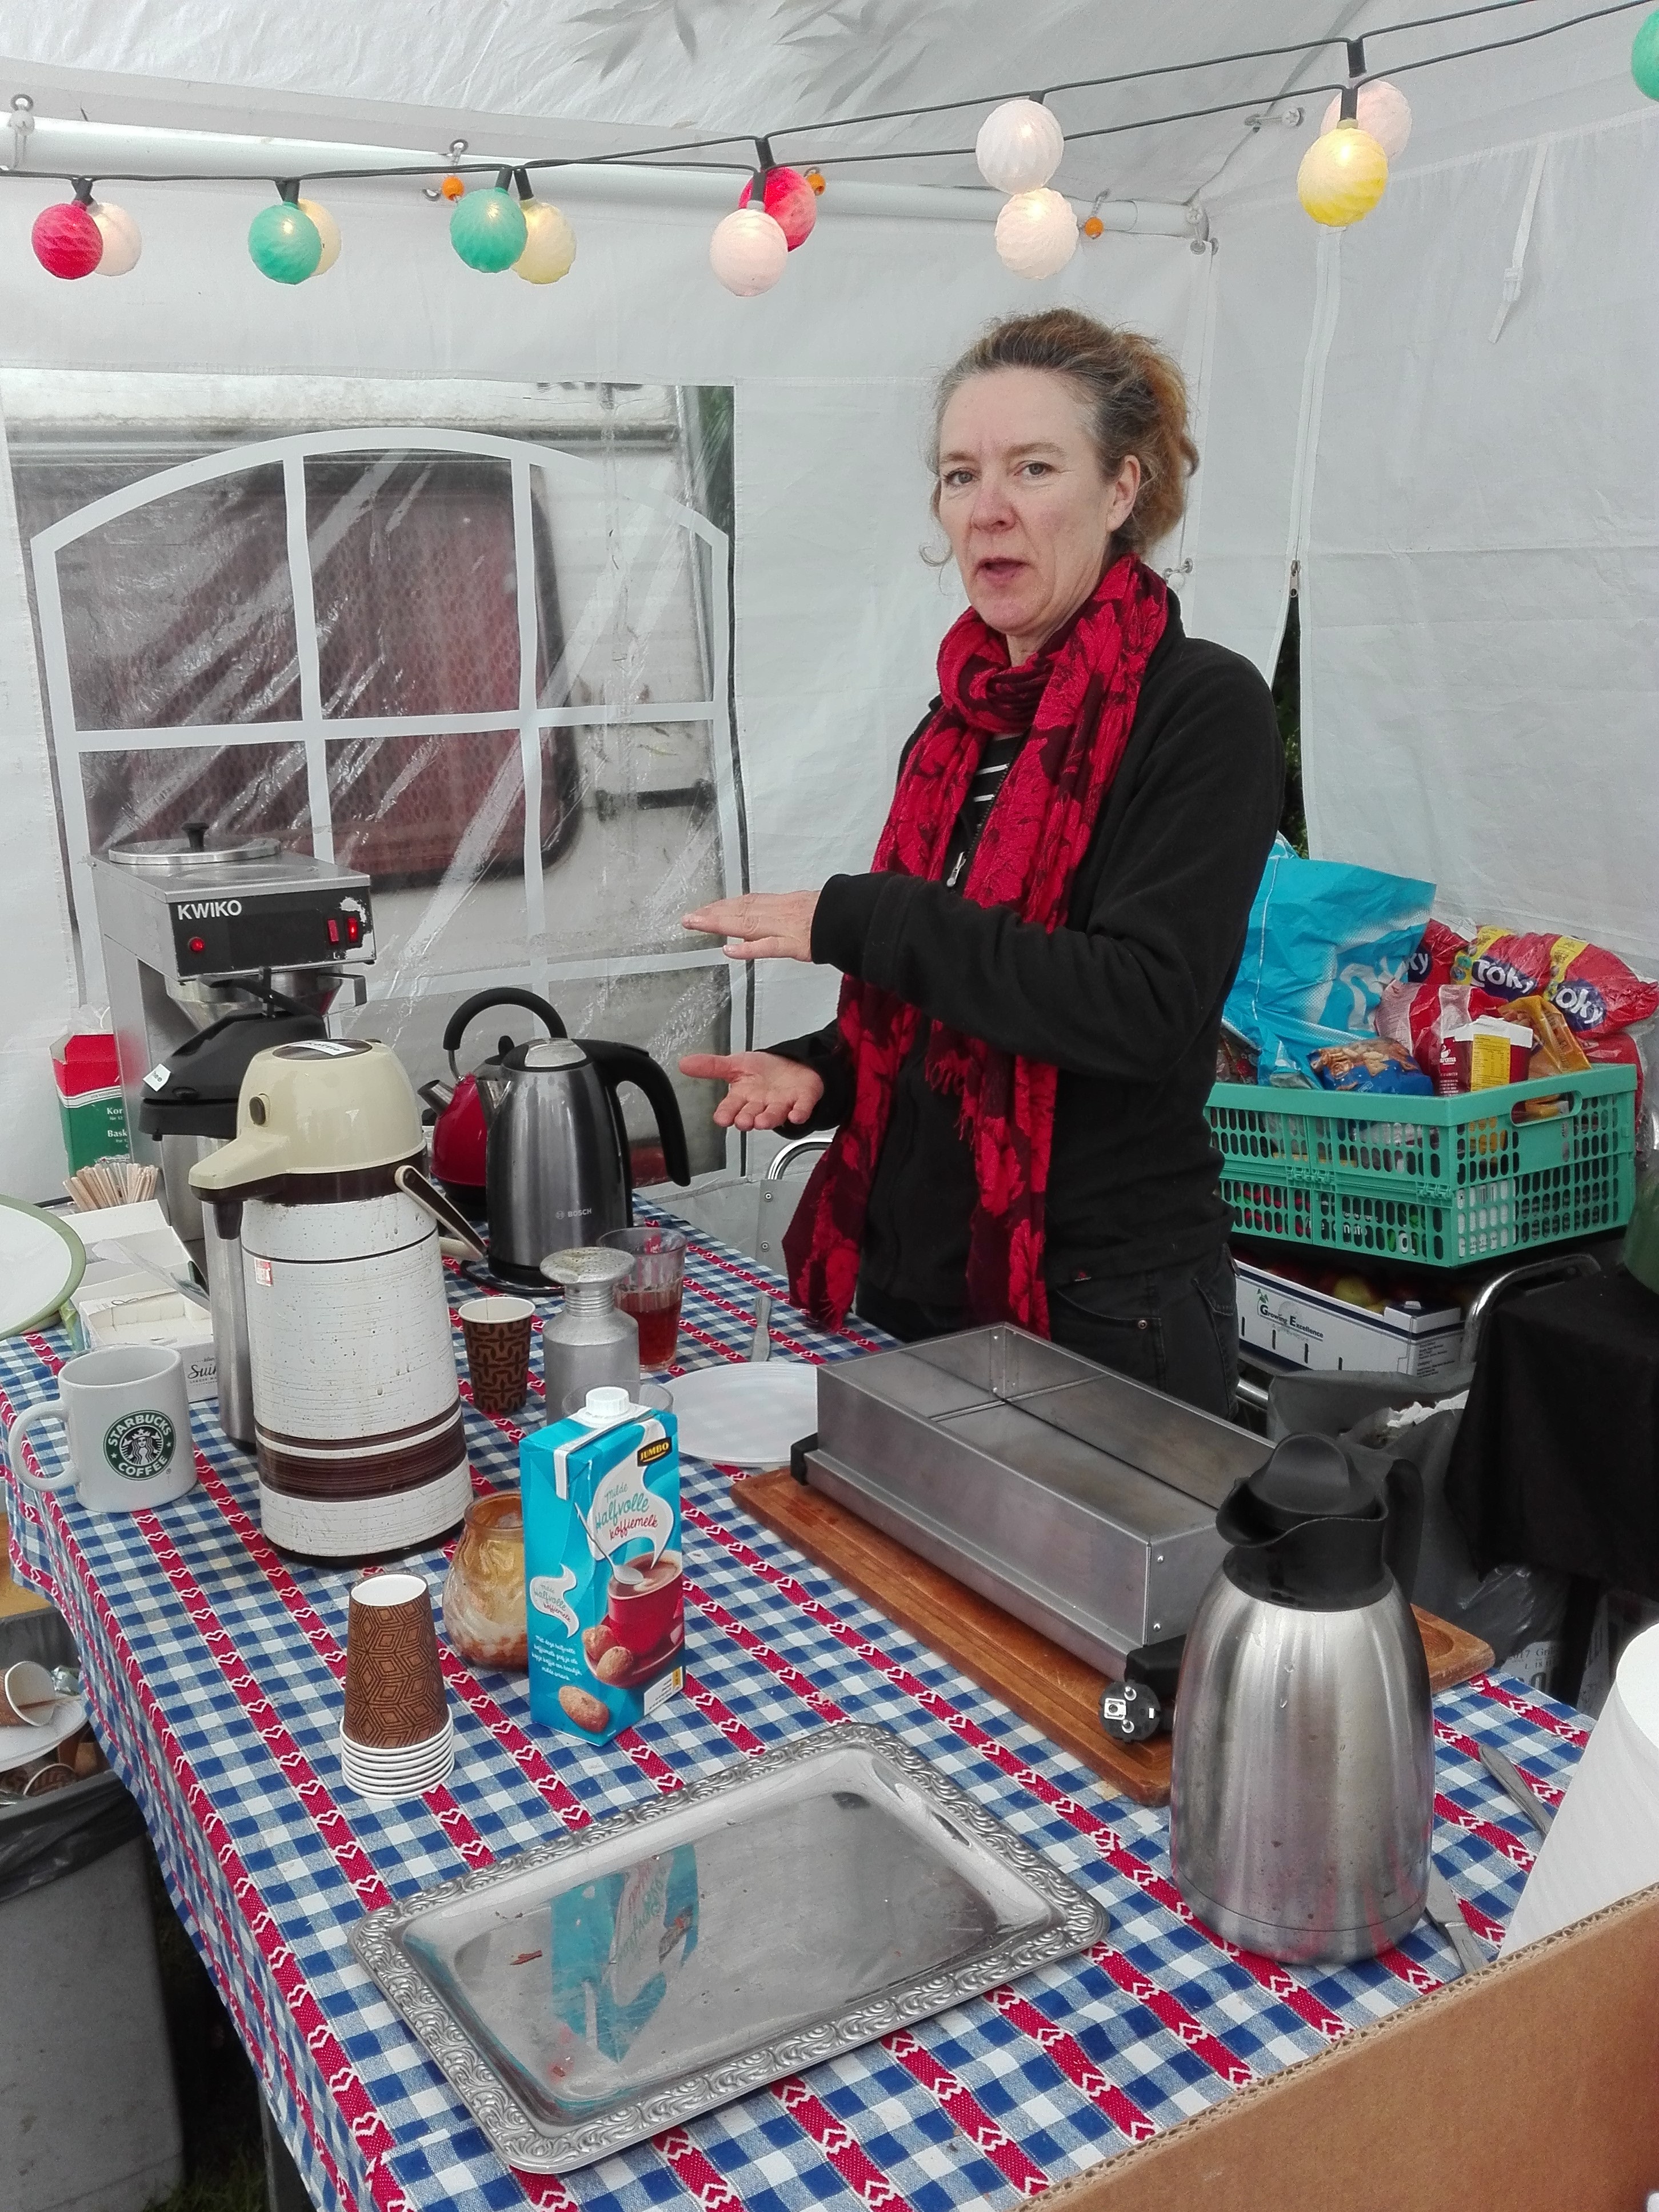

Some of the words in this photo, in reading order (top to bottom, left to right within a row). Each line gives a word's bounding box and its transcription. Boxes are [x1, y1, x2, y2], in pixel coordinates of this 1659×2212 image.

[178, 900, 242, 920] KWIKO
[107, 1129, 127, 1137] Bask
[567, 1208, 592, 1217] BOSCH
[1260, 1304, 1288, 1325] Growing
[1289, 1315, 1324, 1338] Excellence
[107, 1414, 171, 1446] STARBUCKS
[640, 1442, 669, 1459] JUMBO
[118, 1455, 167, 1477] COFFEE
[609, 1514, 658, 1541] koffiemelk
